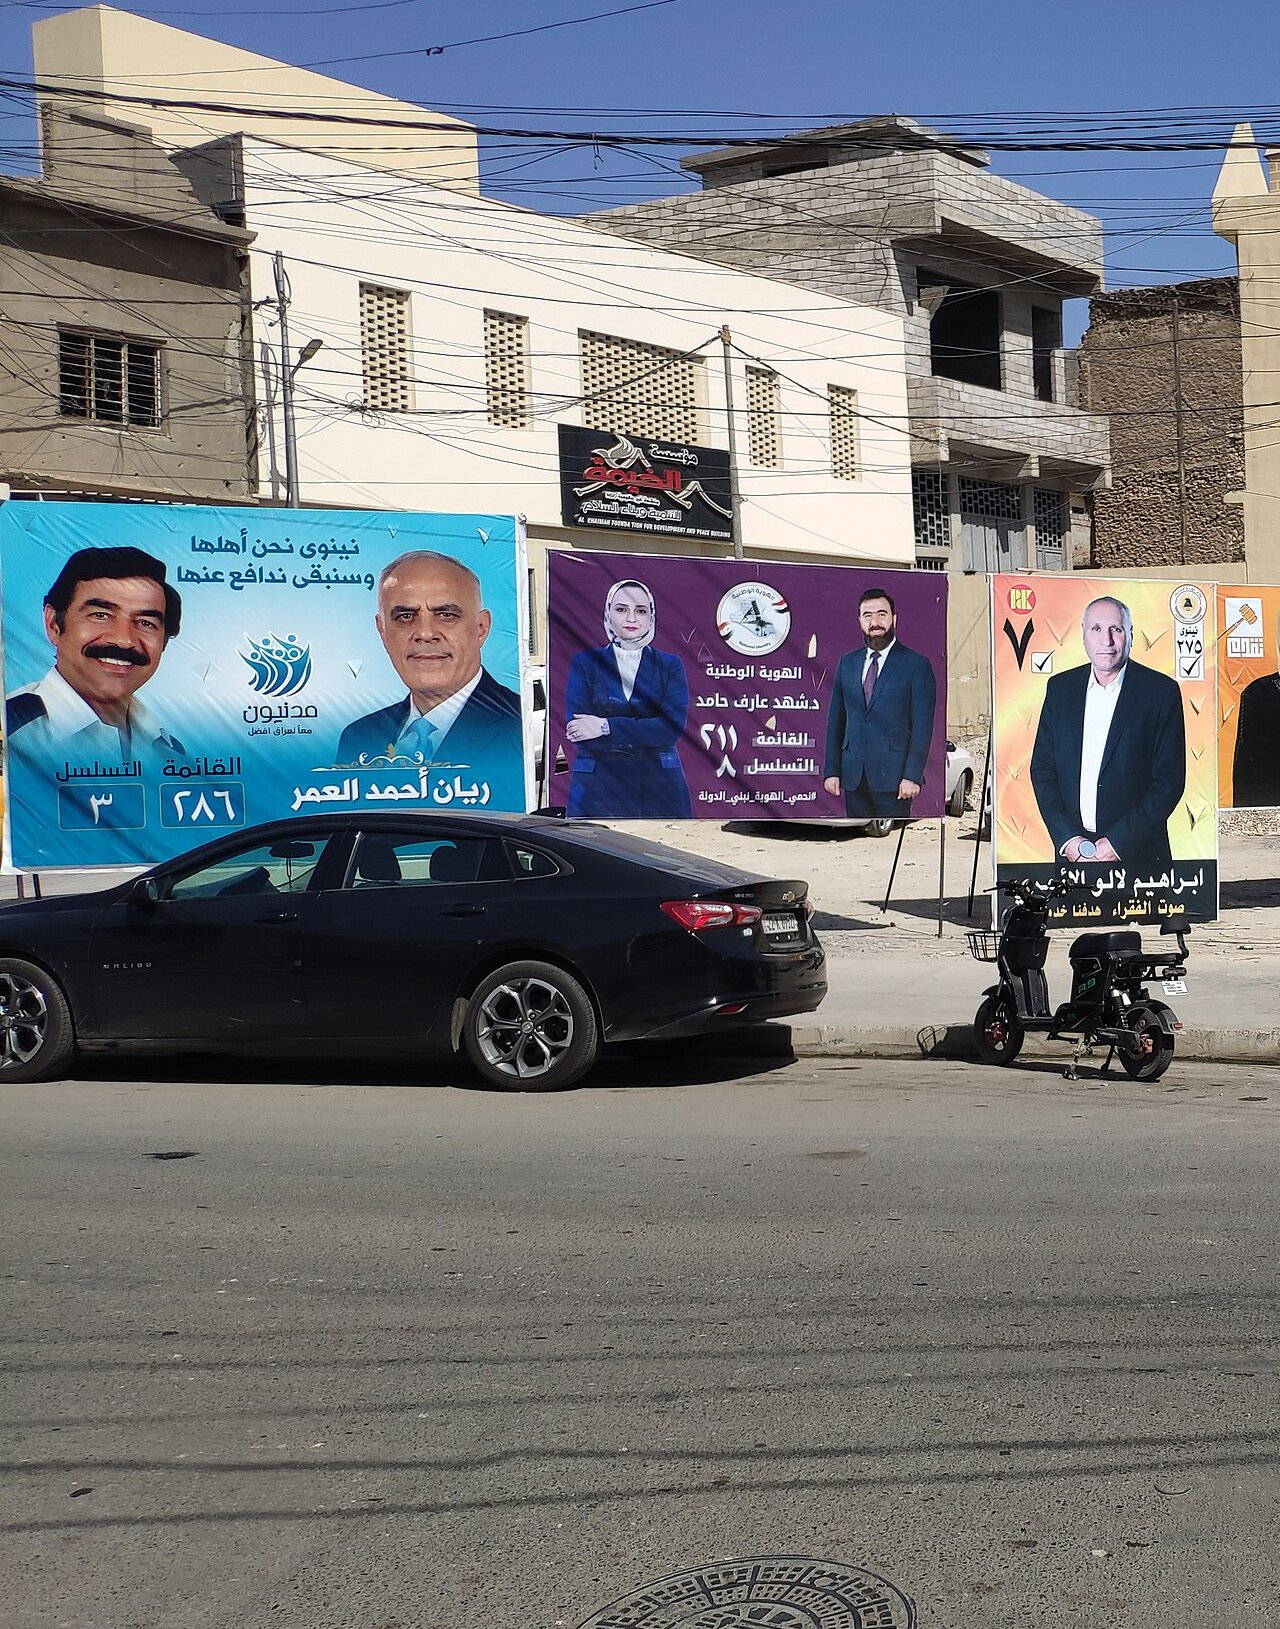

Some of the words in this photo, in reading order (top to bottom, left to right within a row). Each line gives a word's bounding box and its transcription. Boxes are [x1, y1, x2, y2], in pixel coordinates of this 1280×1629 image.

[649, 443, 698, 466] مؤسسة
[582, 457, 682, 493] الخيمة
[581, 499, 620, 516] السلام
[190, 527, 249, 555] أهلها
[251, 537, 295, 558] نحن
[300, 537, 360, 562] نينوى
[176, 564, 226, 585] عنها
[228, 562, 288, 591] ندافع
[292, 563, 375, 591] وسنبقى
[1003, 617, 1035, 672] ٧
[1176, 639, 1203, 655] ٢٧٥
[706, 663, 755, 681] الوطنية
[759, 665, 802, 682] الهوية
[696, 692, 729, 708] حامد
[733, 693, 769, 712] عارف
[242, 701, 319, 724] مدنيون
[247, 726, 271, 737] افضل
[700, 723, 738, 752] ٢١١
[756, 731, 808, 746] القائمة
[55, 760, 142, 783] التسلسل
[162, 756, 242, 779] القائمة
[716, 754, 737, 778] ٨
[748, 757, 815, 775] التسلسل
[290, 776, 360, 812] العمر
[364, 765, 430, 801] أحمد
[432, 774, 492, 806] ريان
[89, 791, 113, 825] ٣
[173, 789, 236, 823] ٢٨٦
[1133, 866, 1204, 898] ابراهيم
[1072, 902, 1102, 918] هدفنا
[1112, 898, 1152, 920] الفقراء
[1157, 898, 1186, 916] صوت
